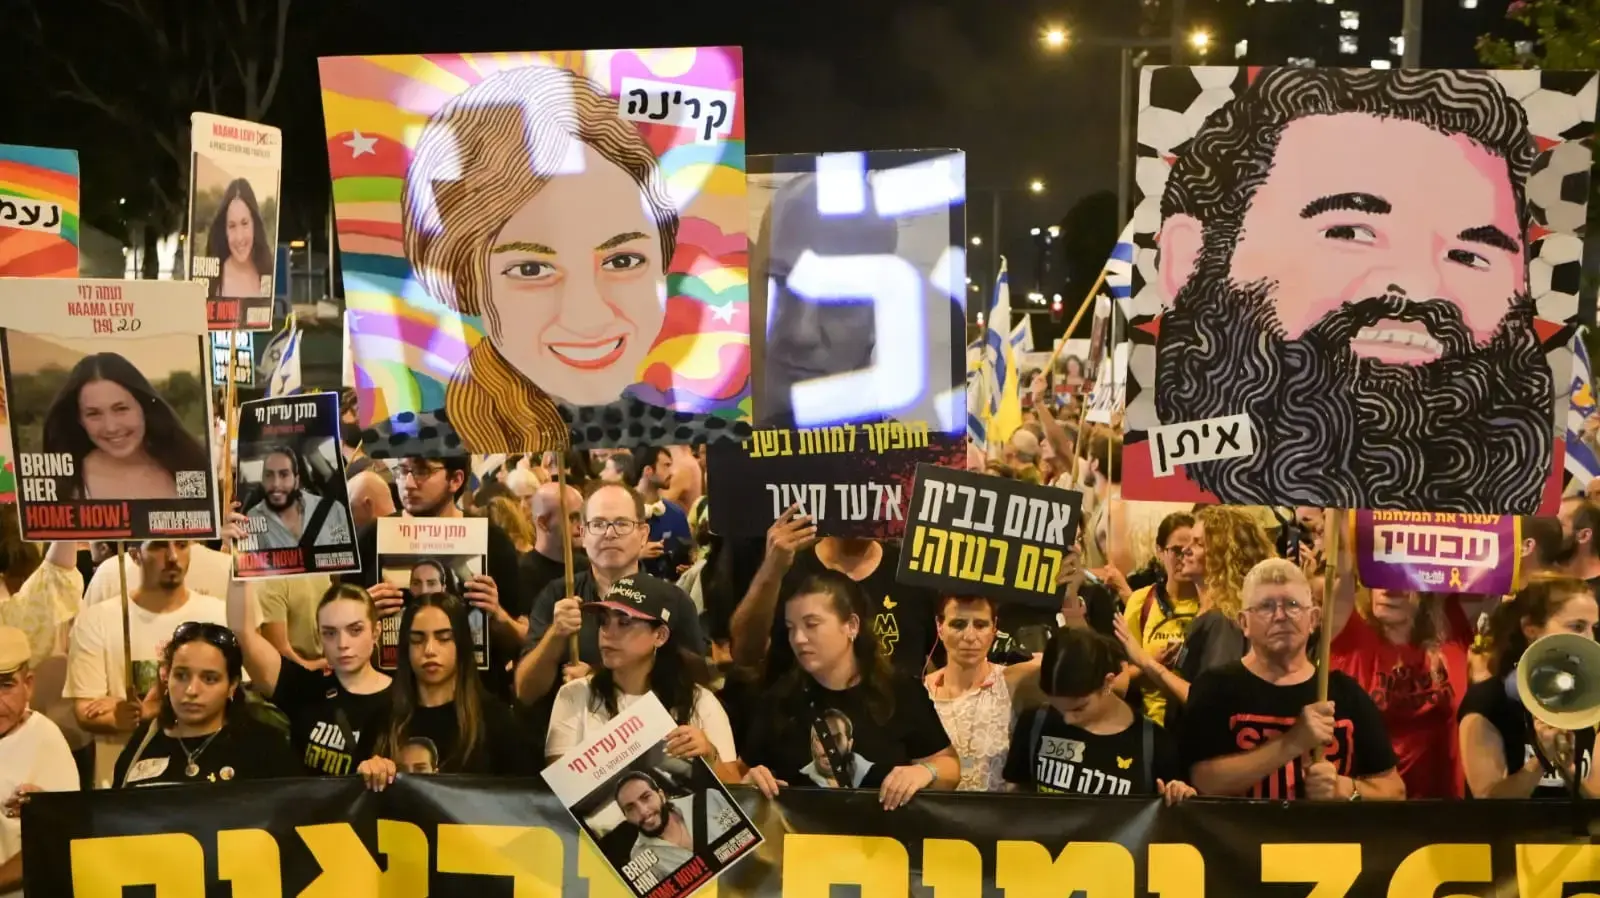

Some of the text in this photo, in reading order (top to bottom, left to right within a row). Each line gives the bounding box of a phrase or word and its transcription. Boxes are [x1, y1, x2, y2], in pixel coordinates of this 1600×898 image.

[628, 88, 727, 140] קרינה
[78, 285, 123, 300] נעמה לוי
[67, 303, 134, 316] NAAMA LEVY
[116, 318, 142, 332] 20
[255, 402, 318, 425] מתן עדיין חי
[799, 423, 856, 455] למוות
[1156, 422, 1241, 472] איתן
[20, 453, 75, 476] BRING
[23, 479, 58, 501] HER
[834, 482, 904, 521] אלעד
[26, 502, 131, 529] HOME NOW!
[918, 479, 1071, 546] אתם בבית
[1373, 510, 1432, 522] המלחמה
[1434, 512, 1457, 523] את
[399, 524, 467, 541] מתן עדיין חי
[1381, 530, 1491, 562] עכשיו
[909, 525, 1063, 594] הם בעזה!
[568, 714, 645, 774] מתן עדיין חי
[1045, 739, 1076, 761] 365
[1036, 756, 1075, 789] שנה
[621, 848, 660, 882] BRING
[675, 855, 709, 888] NOW!
[632, 871, 660, 896] HIM
